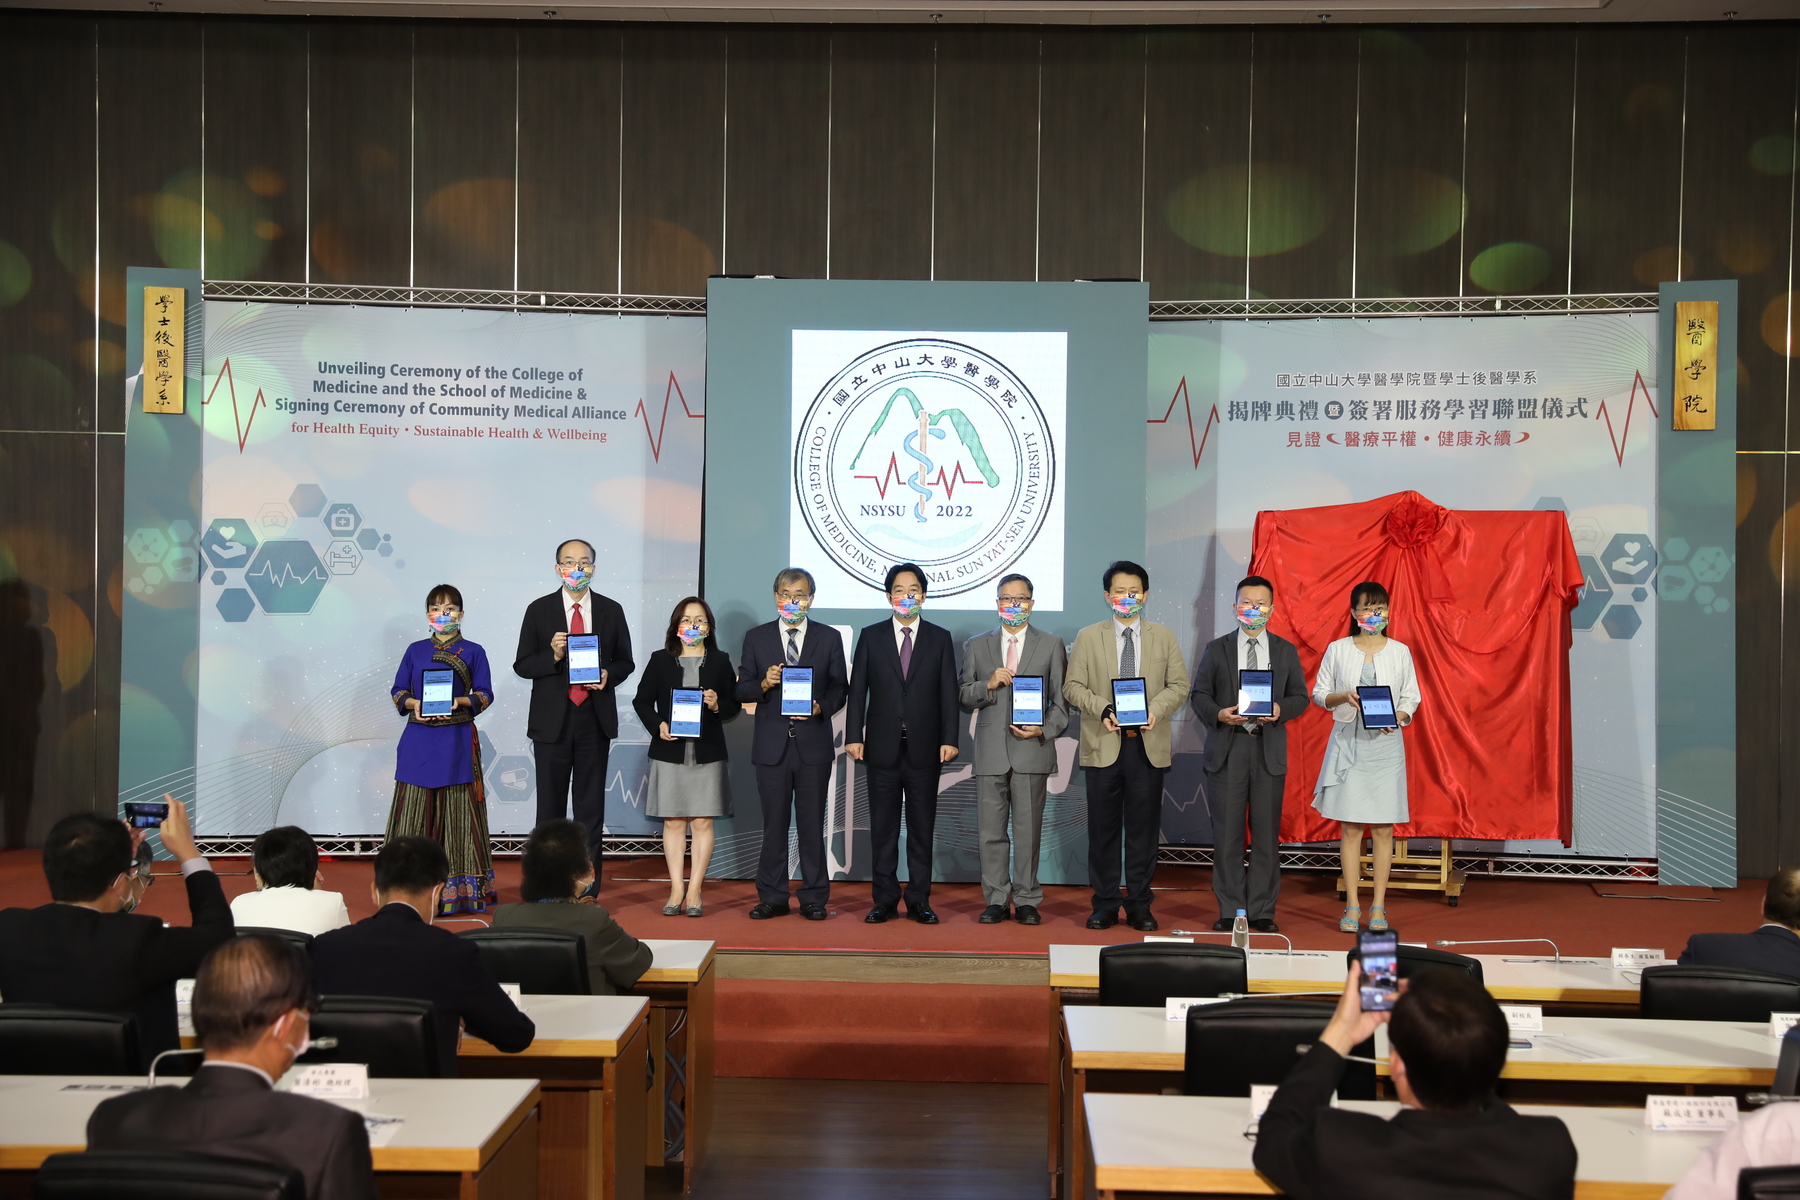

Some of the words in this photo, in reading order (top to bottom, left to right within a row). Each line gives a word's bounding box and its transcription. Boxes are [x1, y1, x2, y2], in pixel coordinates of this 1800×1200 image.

[154, 294, 174, 406] 學士後醫學系
[318, 361, 386, 379] Unveiling
[390, 364, 462, 382] Ceremony
[466, 365, 481, 379] of
[485, 366, 508, 380] the
[512, 367, 564, 384] College
[568, 368, 583, 381] of
[1682, 318, 1707, 414] 醫學院
[313, 380, 378, 394] Medicine
[382, 382, 408, 395] and
[412, 383, 436, 396] the
[440, 384, 487, 398] School
[491, 385, 506, 398] of
[510, 386, 573, 400] Medicine
[577, 388, 587, 400] &
[832, 354, 1018, 408] 國立中山大學醫學院
[1276, 370, 1537, 388] 國立中山大學醫學院暨學士後醫學系
[275, 398, 329, 415] Signing
[333, 399, 406, 418] Ceremony
[410, 401, 425, 415] of
[429, 403, 510, 420] Community
[514, 405, 568, 419] Medical
[571, 406, 627, 420] Alliance
[1227, 400, 1319, 422] 揭牌典禮
[1348, 397, 1588, 421] 簽署服務學習聯盟儀式
[291, 422, 309, 433] for
[313, 422, 355, 434] Health
[359, 423, 400, 438] Equity
[414, 424, 484, 438] Sustainable
[488, 426, 529, 439] Health
[533, 428, 544, 439] &
[547, 428, 607, 443] Wellbeing
[1286, 431, 1321, 448] 見證
[1344, 431, 1417, 448] 醫療平權
[1437, 430, 1512, 447] 健康永續
[809, 426, 826, 491] COLLEGE
[1020, 432, 1040, 515] UNIVERSITY
[813, 493, 828, 511] OF
[860, 504, 906, 517] NSYSU
[936, 505, 973, 517] 2022
[821, 514, 877, 573] MEDICINE,
[983, 517, 1026, 562] YAT-SEN
[957, 558, 984, 577] SUN
